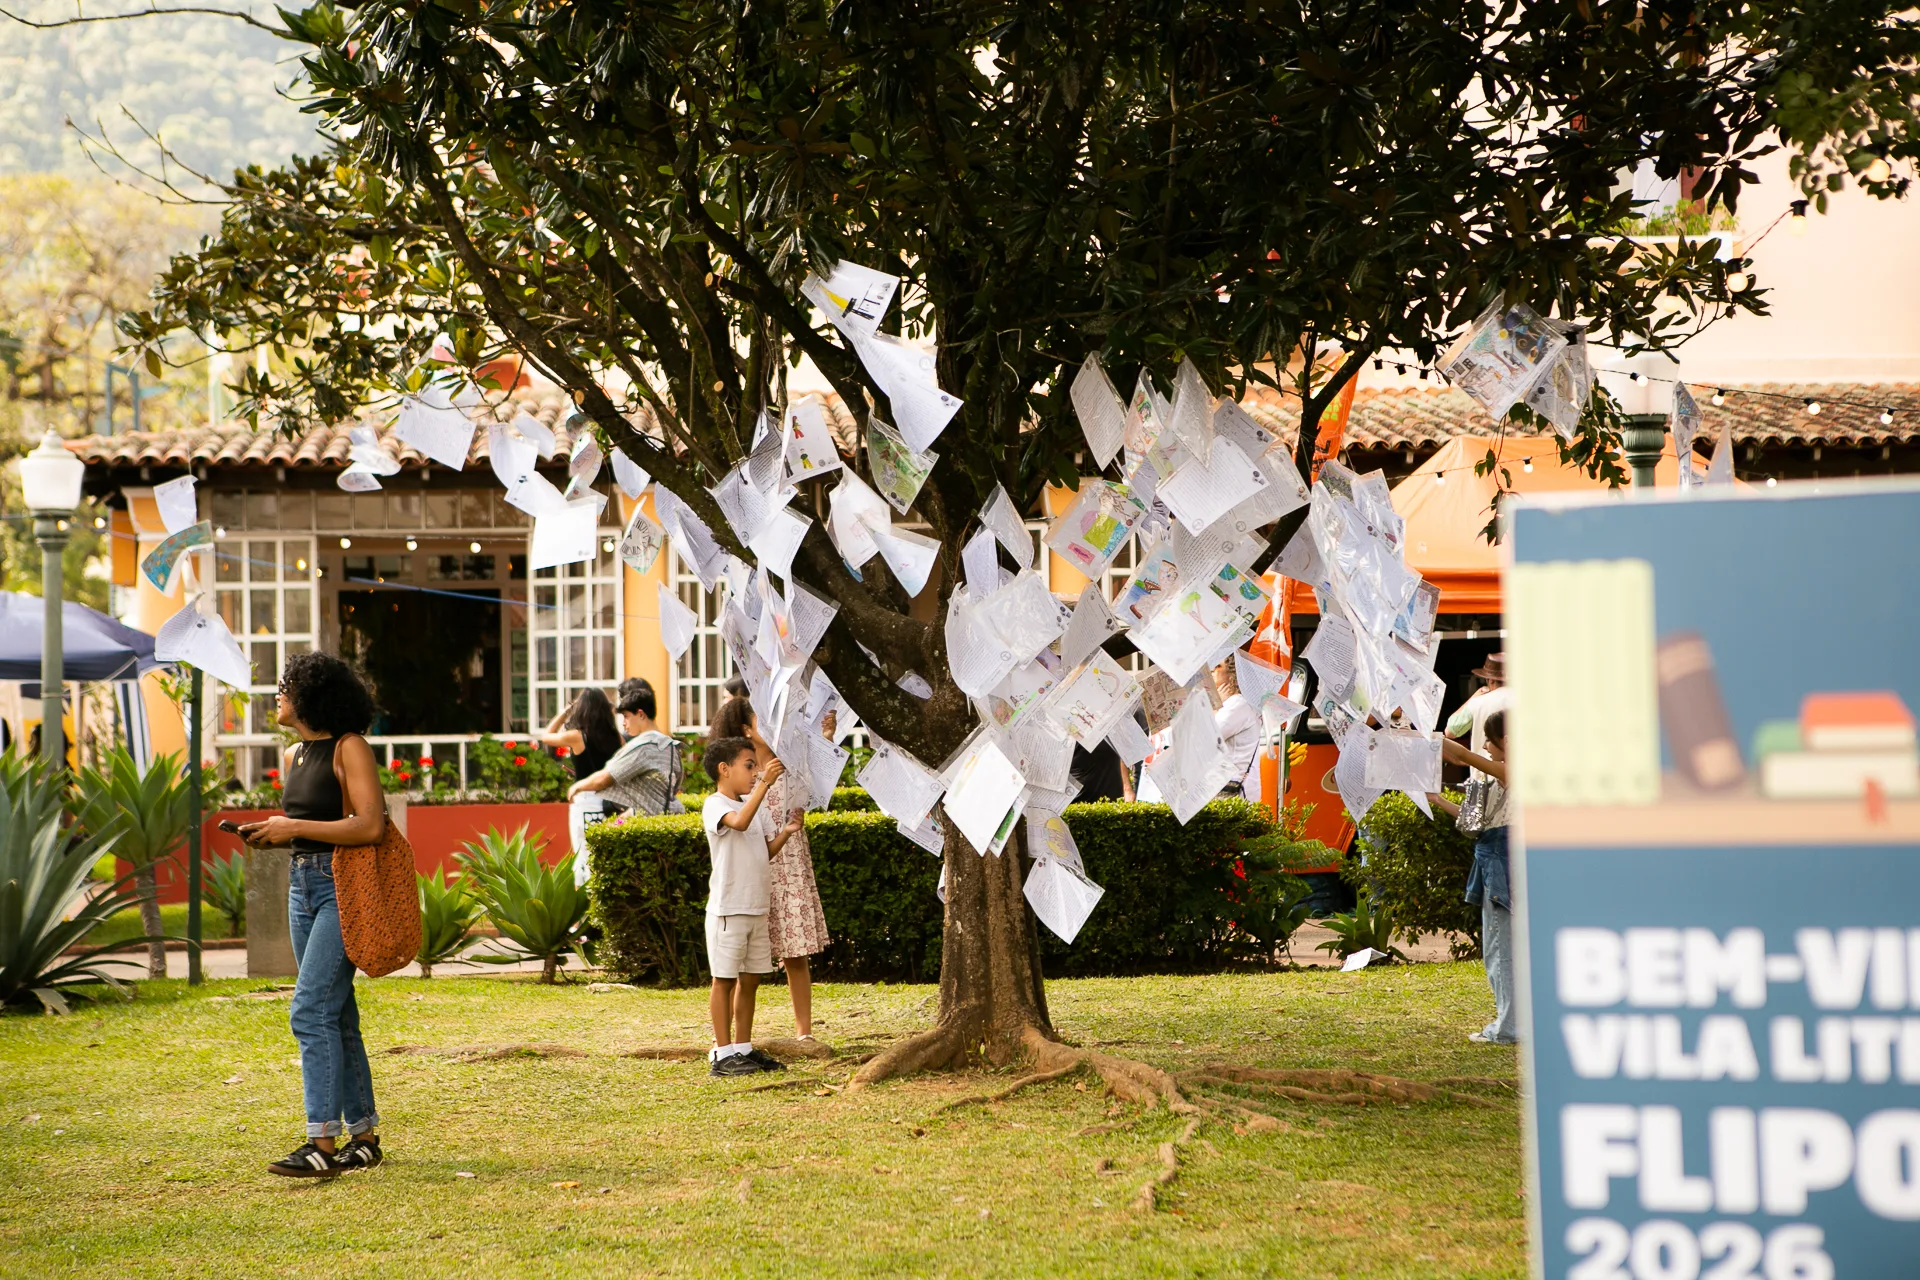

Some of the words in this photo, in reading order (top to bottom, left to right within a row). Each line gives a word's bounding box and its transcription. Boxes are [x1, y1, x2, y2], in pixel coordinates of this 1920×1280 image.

[1556, 927, 1920, 1009] BEM-VI
[1562, 1014, 1759, 1080] VILA
[1561, 1104, 1920, 1219] FLIPO
[1566, 1218, 1833, 1280] 2026
